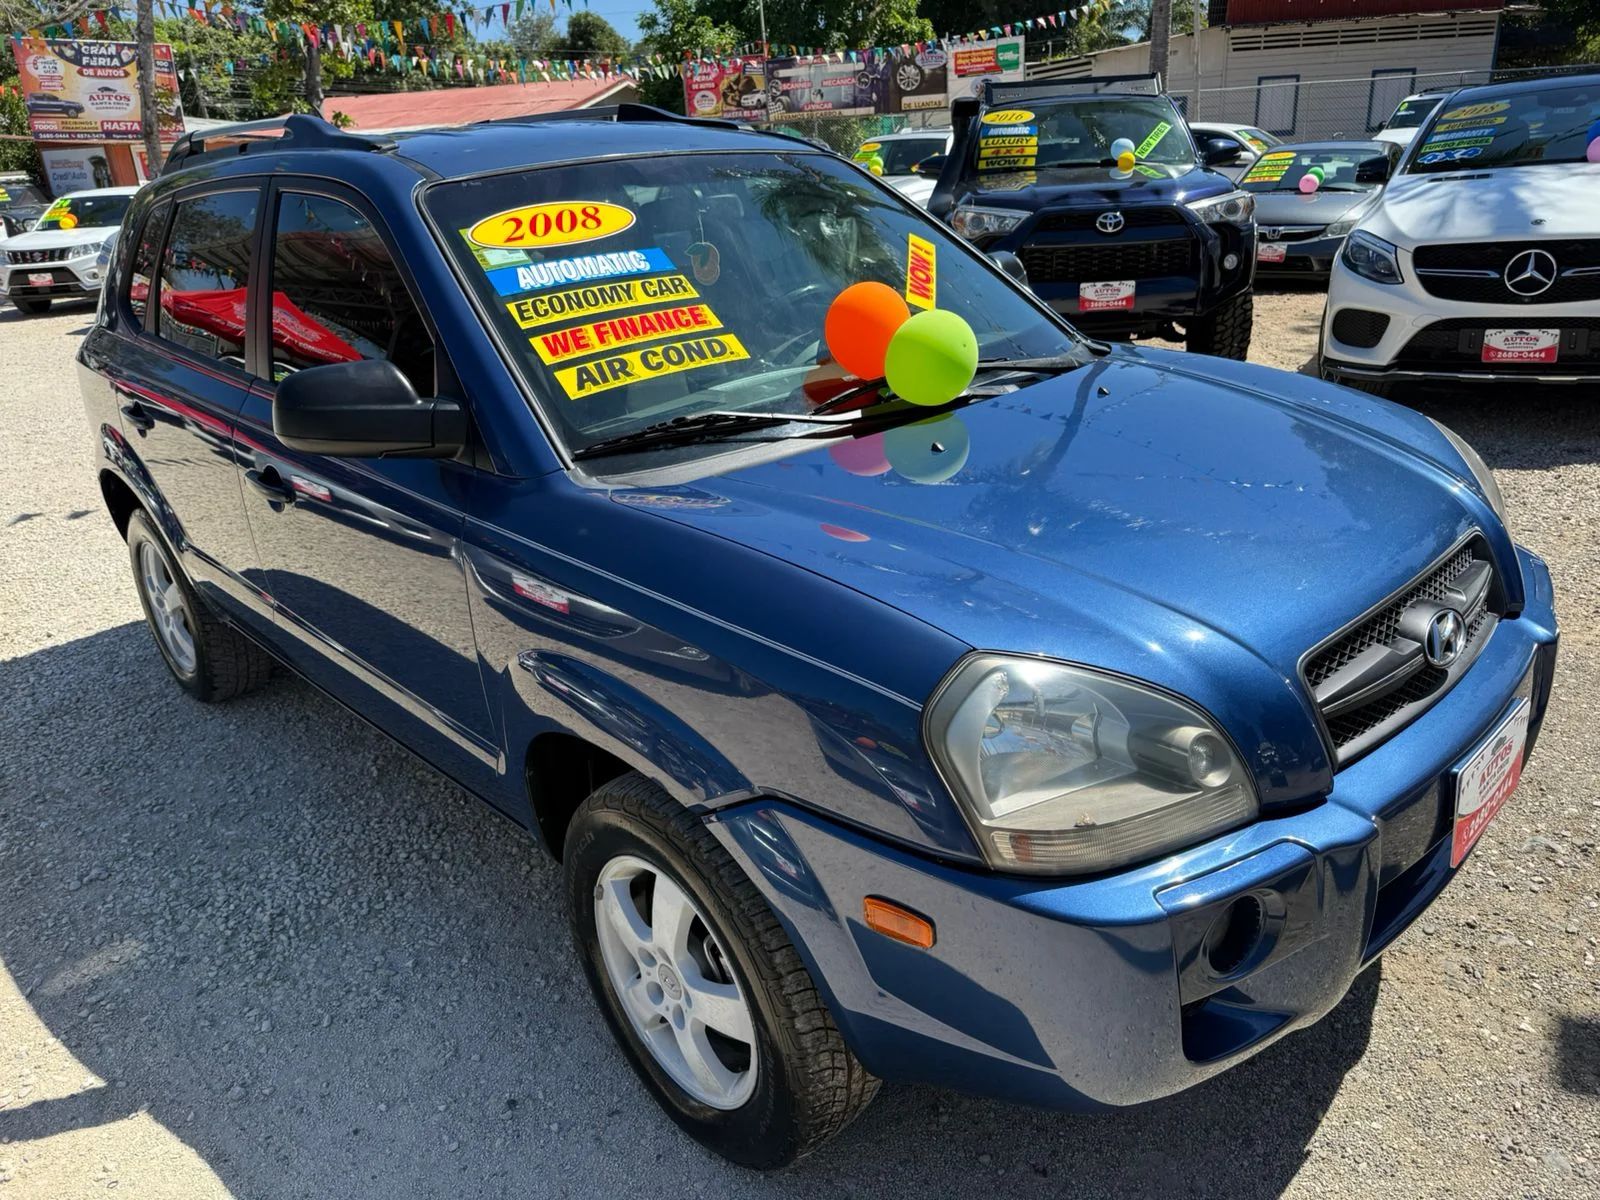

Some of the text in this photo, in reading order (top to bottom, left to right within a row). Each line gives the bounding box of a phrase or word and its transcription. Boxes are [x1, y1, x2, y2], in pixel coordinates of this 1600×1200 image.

[82, 57, 120, 66] FERIA
[782, 81, 812, 89] SCANNER
[89, 94, 131, 102] AUTOS
[804, 102, 832, 110] LAVACAR
[1455, 103, 1500, 118] 2018
[990, 113, 1024, 122] 2016
[1445, 118, 1498, 129] AUTOMATIC
[103, 121, 140, 130] HASTA
[988, 126, 1031, 135] AUTOMATIC
[984, 138, 1032, 146] LUXURY
[1137, 124, 1168, 156] NEW TIRES
[1431, 128, 1494, 142] WARRANTY
[1424, 137, 1491, 151] TURBO DIESEL
[502, 206, 602, 243] 2008
[517, 251, 650, 289] AUTOMATIC
[514, 277, 689, 322] ECONOMY CAR
[541, 307, 708, 357] WE FINANCE
[576, 337, 736, 391] AIR COND.
[1479, 739, 1514, 788] AUTOS
